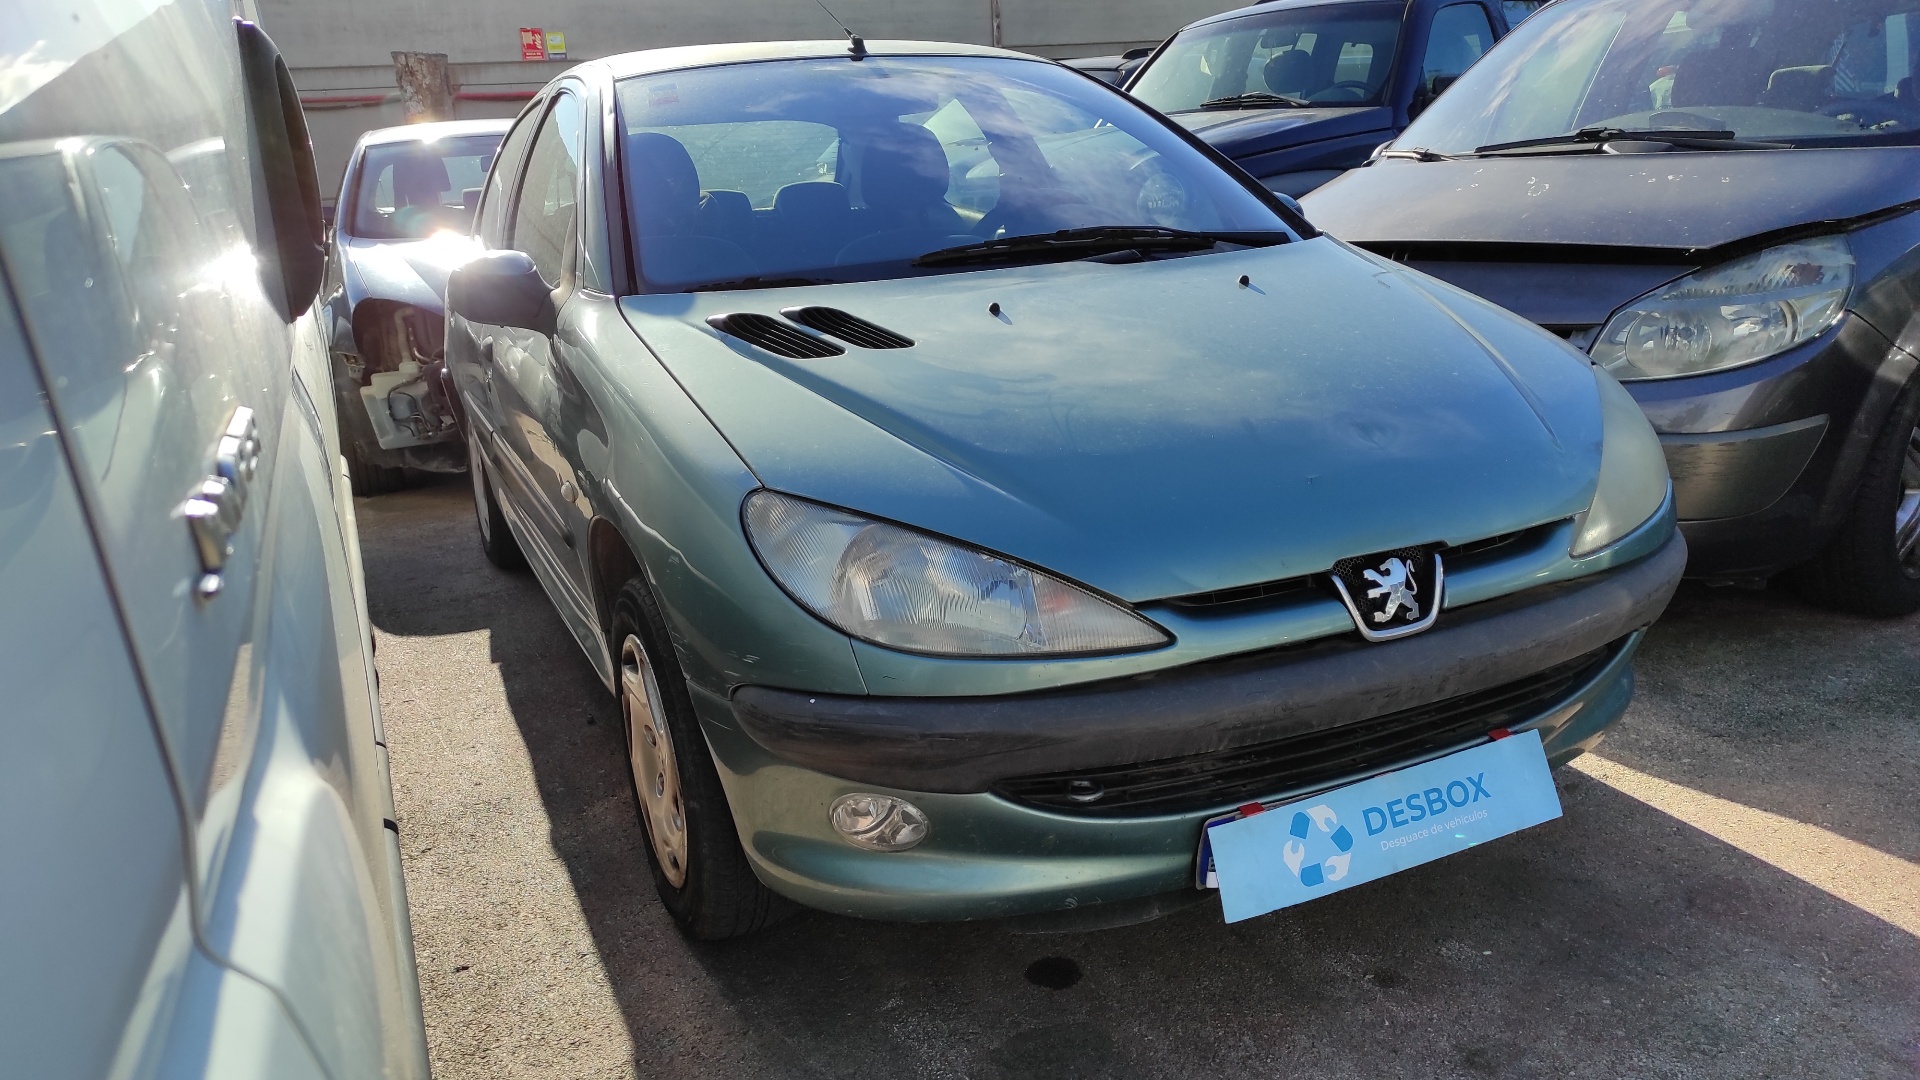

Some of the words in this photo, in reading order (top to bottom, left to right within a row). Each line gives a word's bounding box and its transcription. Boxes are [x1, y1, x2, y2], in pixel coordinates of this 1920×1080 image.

[1362, 772, 1491, 836] DESBOX
[1380, 829, 1429, 851] Desguace
[1431, 823, 1443, 835] de
